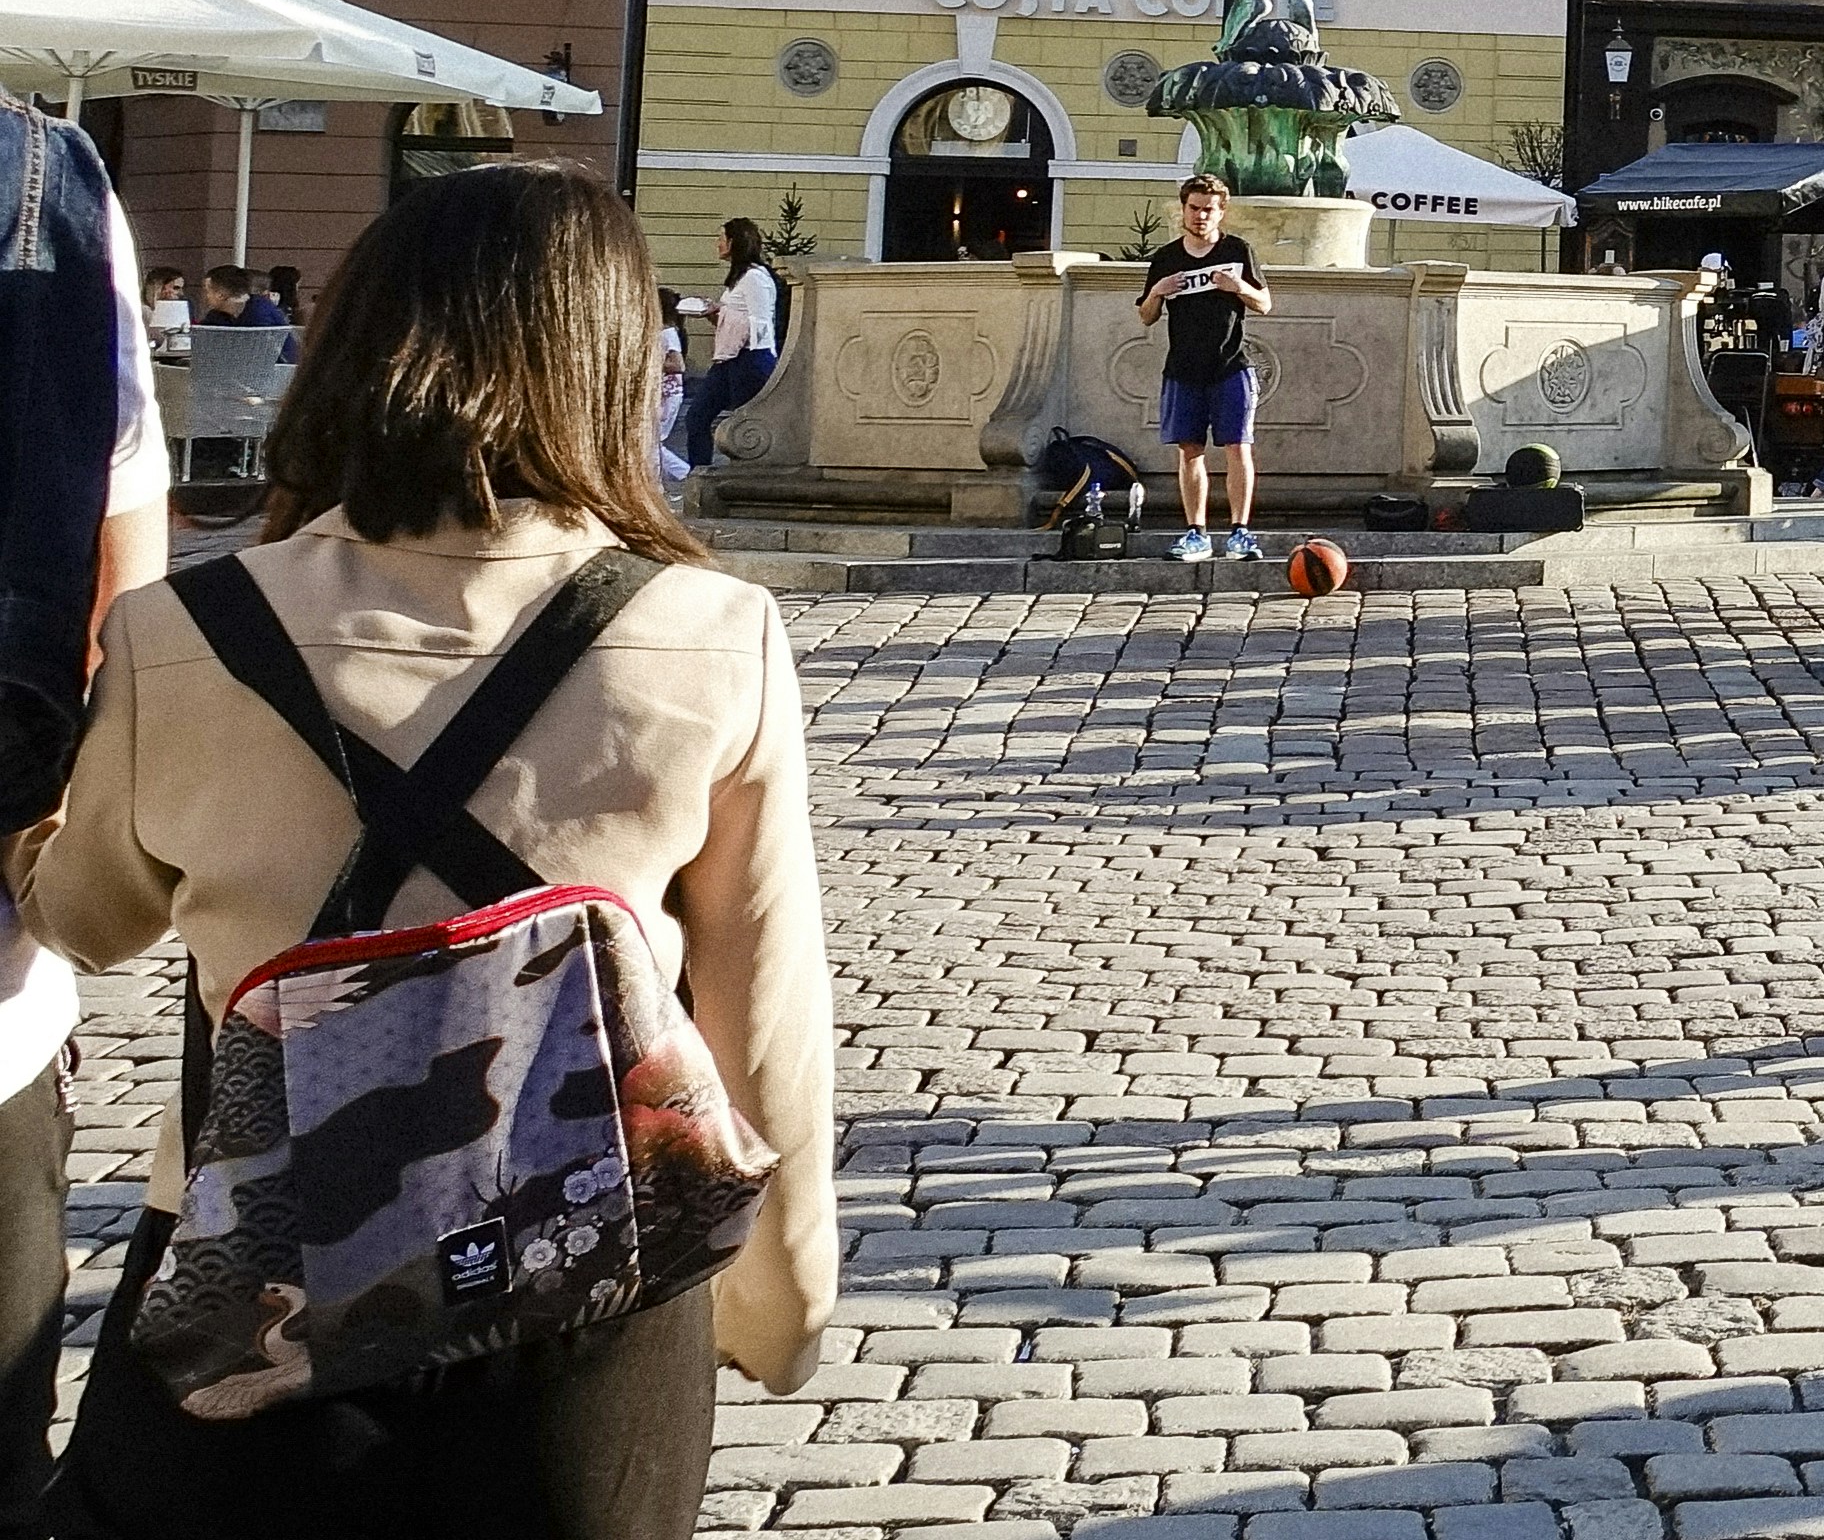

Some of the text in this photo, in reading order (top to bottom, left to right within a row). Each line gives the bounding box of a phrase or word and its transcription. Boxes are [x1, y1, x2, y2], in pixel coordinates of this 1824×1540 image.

[134, 70, 195, 87] TYSKIE
[1371, 191, 1479, 216] COFFEE
[1617, 194, 1722, 212] www.bikecafe.pl
